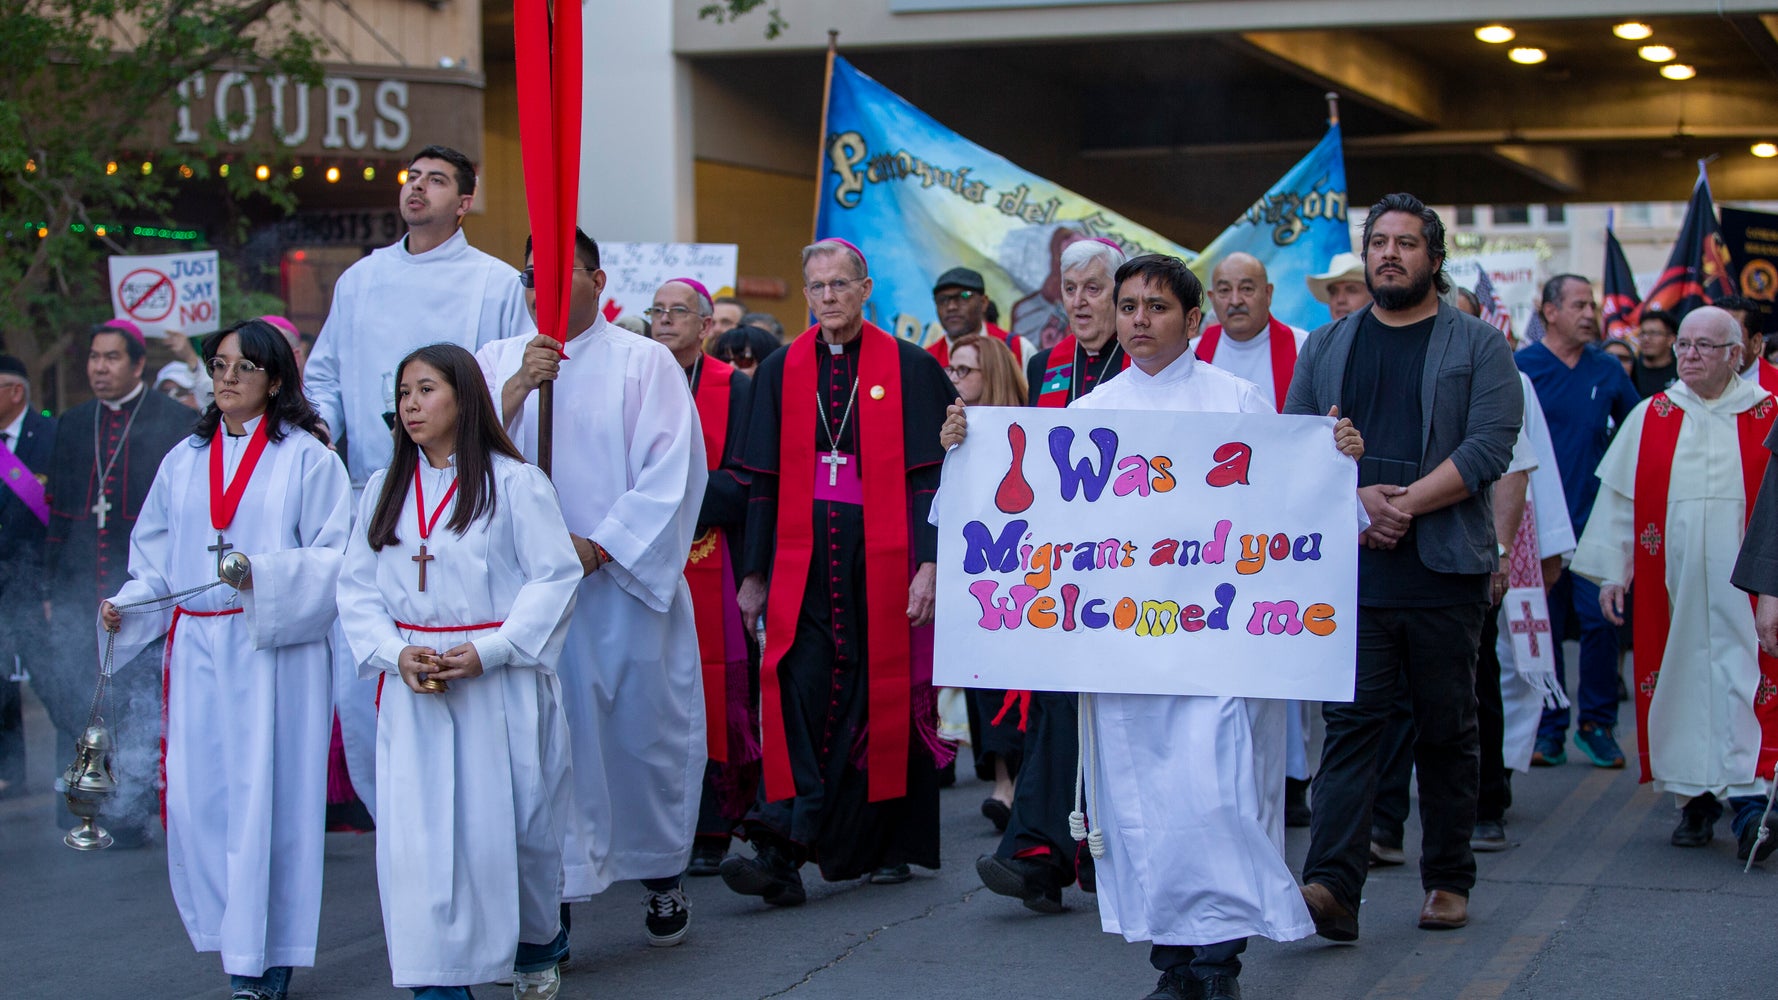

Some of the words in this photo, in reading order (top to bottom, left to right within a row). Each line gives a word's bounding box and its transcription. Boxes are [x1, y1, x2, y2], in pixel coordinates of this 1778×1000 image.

[176, 71, 411, 150] TOURS
[998, 183, 1061, 223] del
[170, 258, 215, 279] JUST
[181, 281, 213, 302] SAY
[995, 422, 1034, 514] I
[1048, 426, 1176, 502] Was
[1206, 442, 1252, 488] a
[962, 519, 1136, 590] Migrant
[1149, 519, 1232, 567] and
[1235, 532, 1322, 575] you
[968, 579, 1236, 637] Welcomed
[1246, 600, 1337, 636] me
